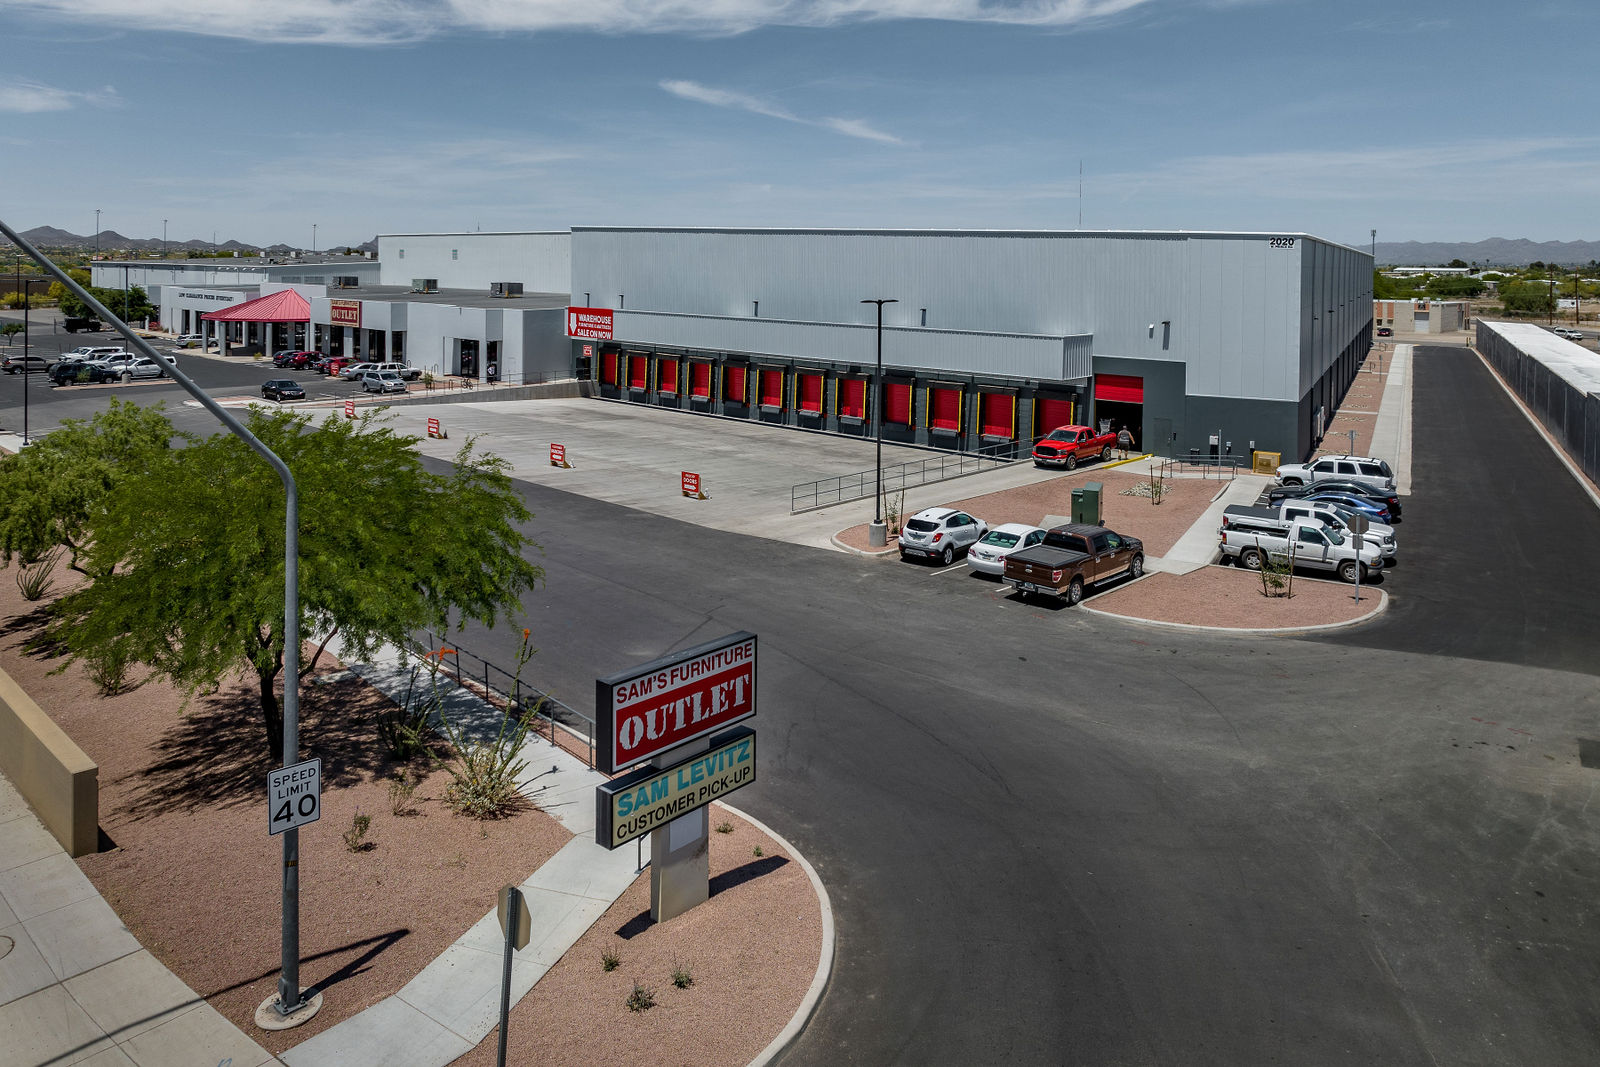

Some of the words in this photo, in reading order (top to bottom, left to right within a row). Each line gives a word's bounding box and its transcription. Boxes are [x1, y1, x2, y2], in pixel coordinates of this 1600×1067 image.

[1270, 237, 1295, 246] 2020
[332, 308, 357, 320] OUTLET
[578, 313, 612, 325] WAREHOUSE
[577, 328, 590, 337] SALE
[589, 329, 598, 338] ON
[598, 330, 612, 339] NOW
[616, 672, 669, 704] SAM'S
[670, 642, 753, 684] FURNITURE
[619, 673, 750, 750] OUTLET
[273, 767, 316, 788] SPEED
[617, 775, 669, 818] SAM
[677, 740, 751, 790] LEVITZ
[278, 781, 312, 799] LIMIT
[273, 793, 317, 823] 40
[616, 792, 695, 840] CUSTOMER
[699, 766, 751, 801] PICK-UP
